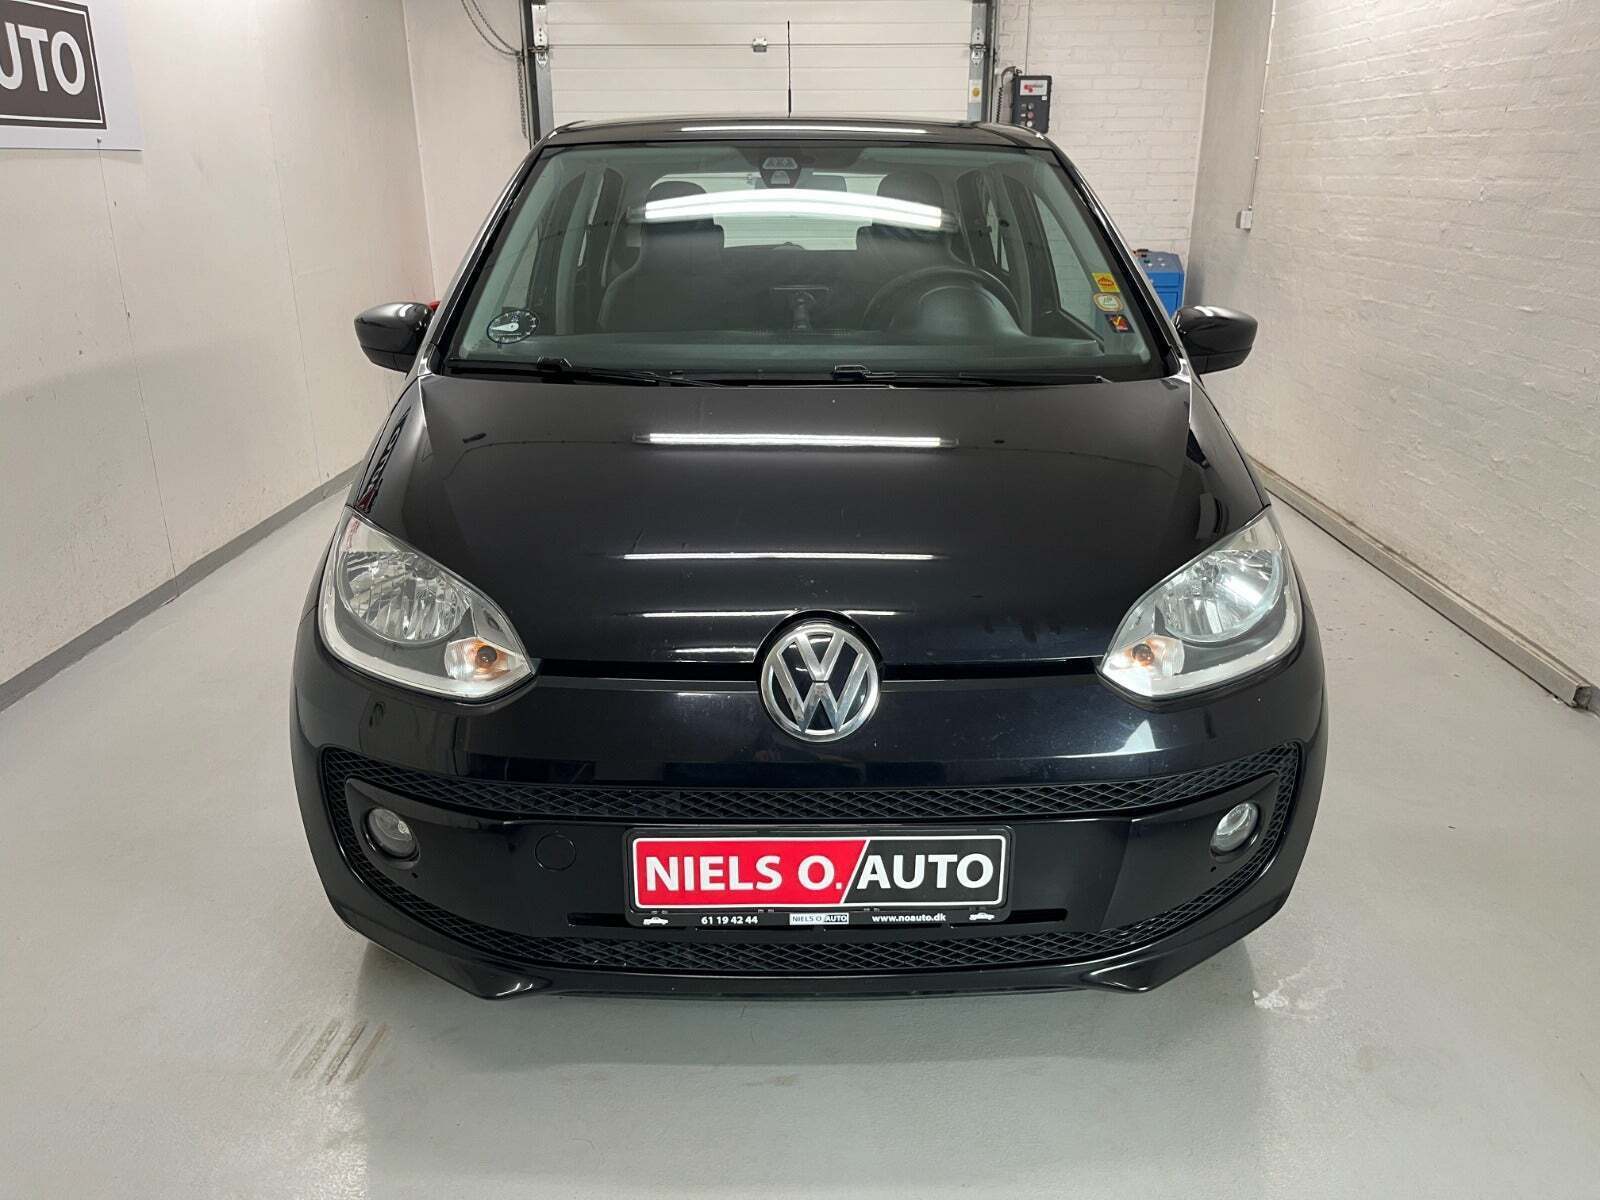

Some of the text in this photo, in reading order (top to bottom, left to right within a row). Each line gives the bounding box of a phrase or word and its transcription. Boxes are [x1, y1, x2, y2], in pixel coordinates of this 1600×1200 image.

[645, 853, 994, 892] NIELS O. AUTO
[701, 916, 758, 925] 61 19 42 44
[825, 914, 847, 922] AUTO
[872, 913, 946, 922] www.noauto.dk
